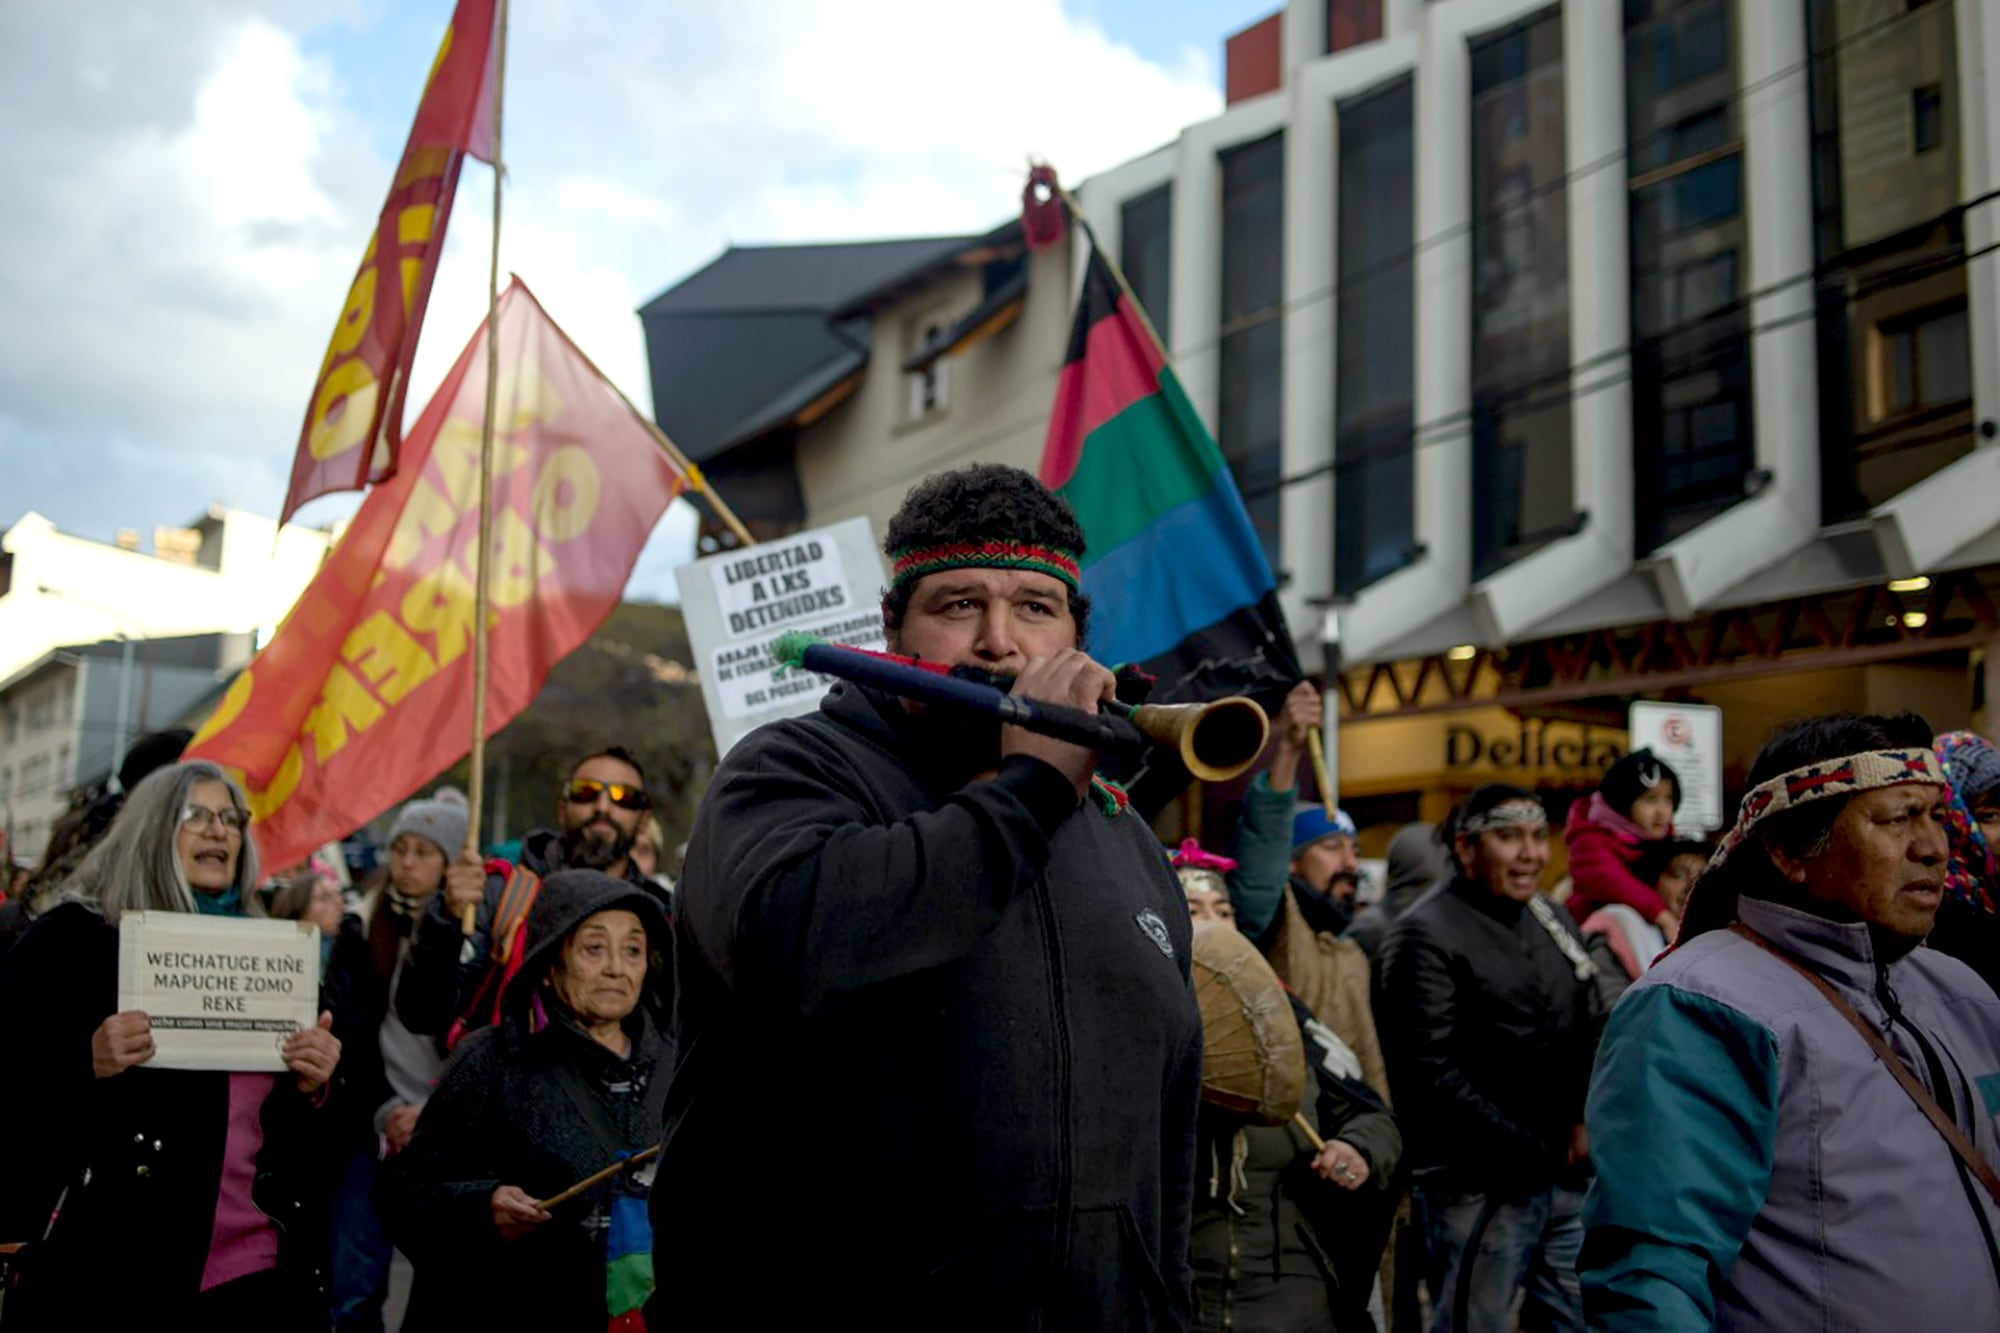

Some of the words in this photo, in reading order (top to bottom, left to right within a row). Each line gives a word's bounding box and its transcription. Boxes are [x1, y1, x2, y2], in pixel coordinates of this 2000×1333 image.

[723, 541, 824, 585] LIBERTAD
[752, 581, 767, 602] A
[770, 569, 811, 596] LXS
[729, 585, 845, 635] DETENIDXS
[147, 951, 261, 973] WEICHATUGE
[266, 955, 305, 974] KIÑE
[154, 973, 239, 992] MAPUCHE
[244, 977, 293, 993] ZOMO
[202, 996, 247, 1012] REKE
